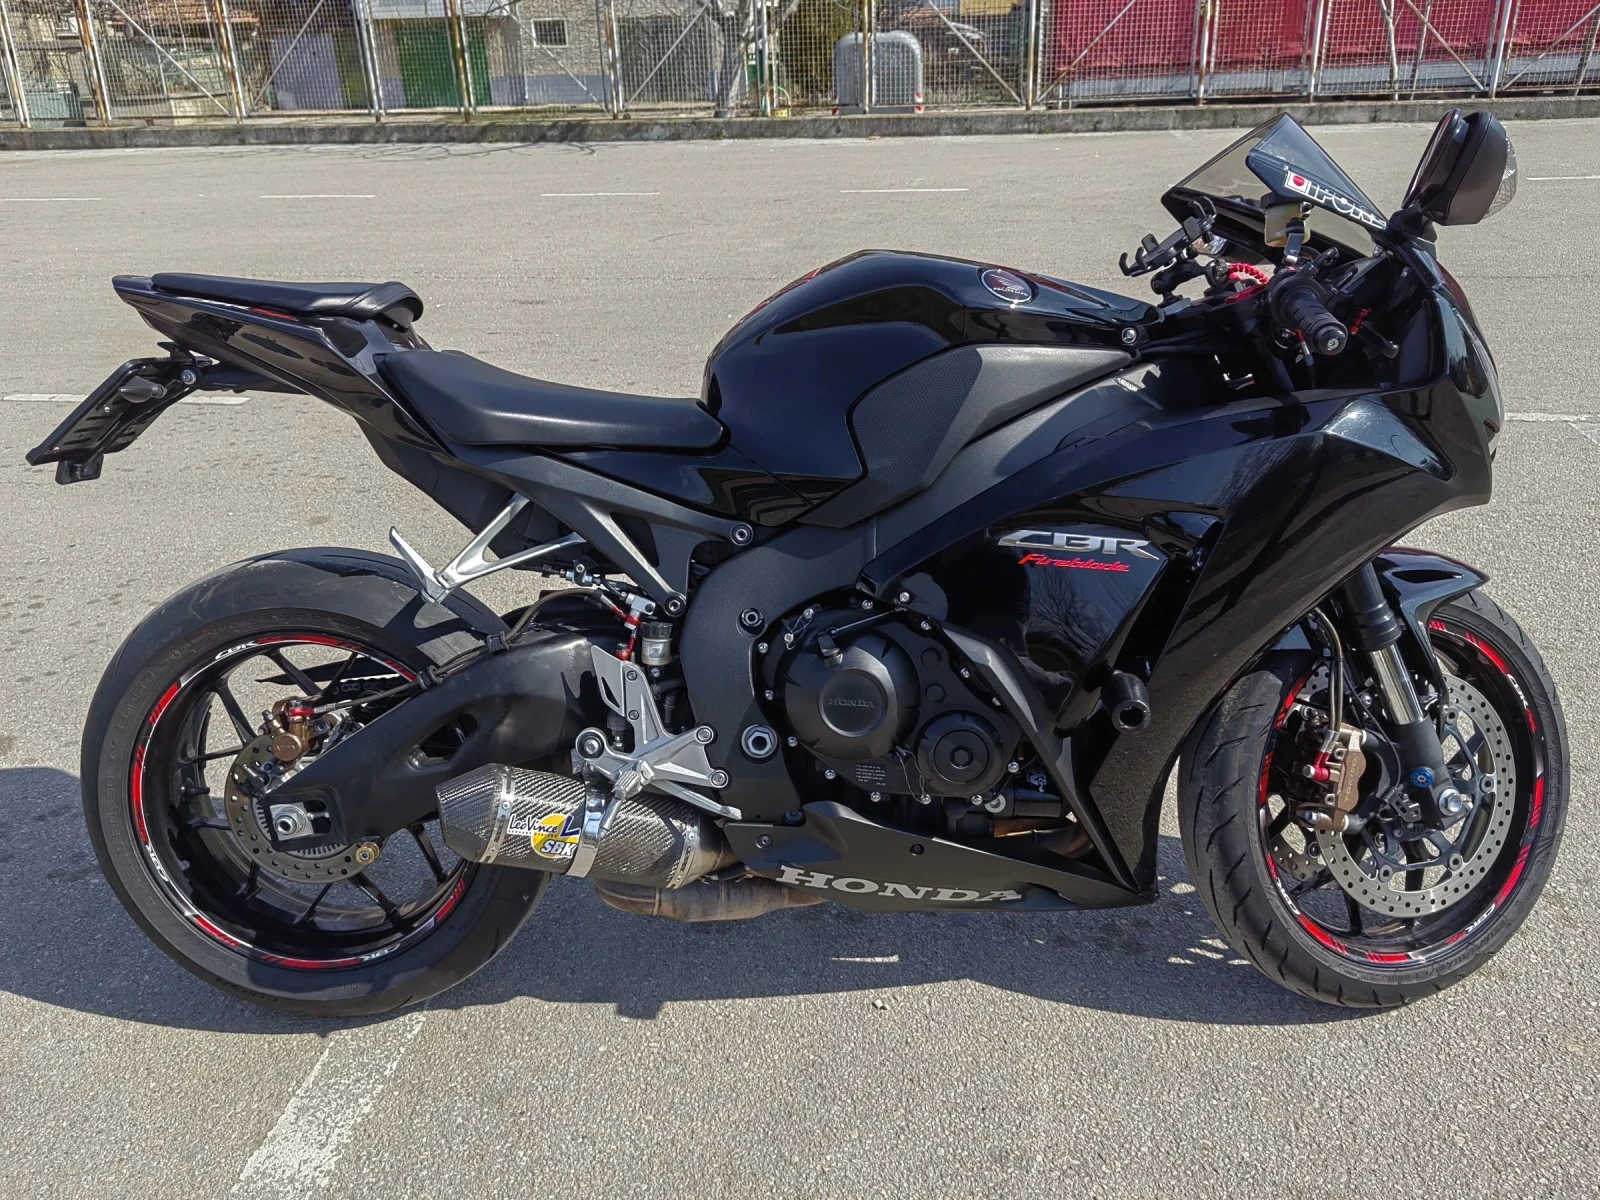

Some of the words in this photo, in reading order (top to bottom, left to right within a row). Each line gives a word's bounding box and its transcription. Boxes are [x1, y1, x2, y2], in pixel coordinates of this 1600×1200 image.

[998, 529, 1160, 561] CBR
[1018, 553, 1130, 572] Fireblade
[828, 697, 877, 708] HONDA
[541, 840, 577, 857] SBK
[776, 865, 1022, 902] HONDA
